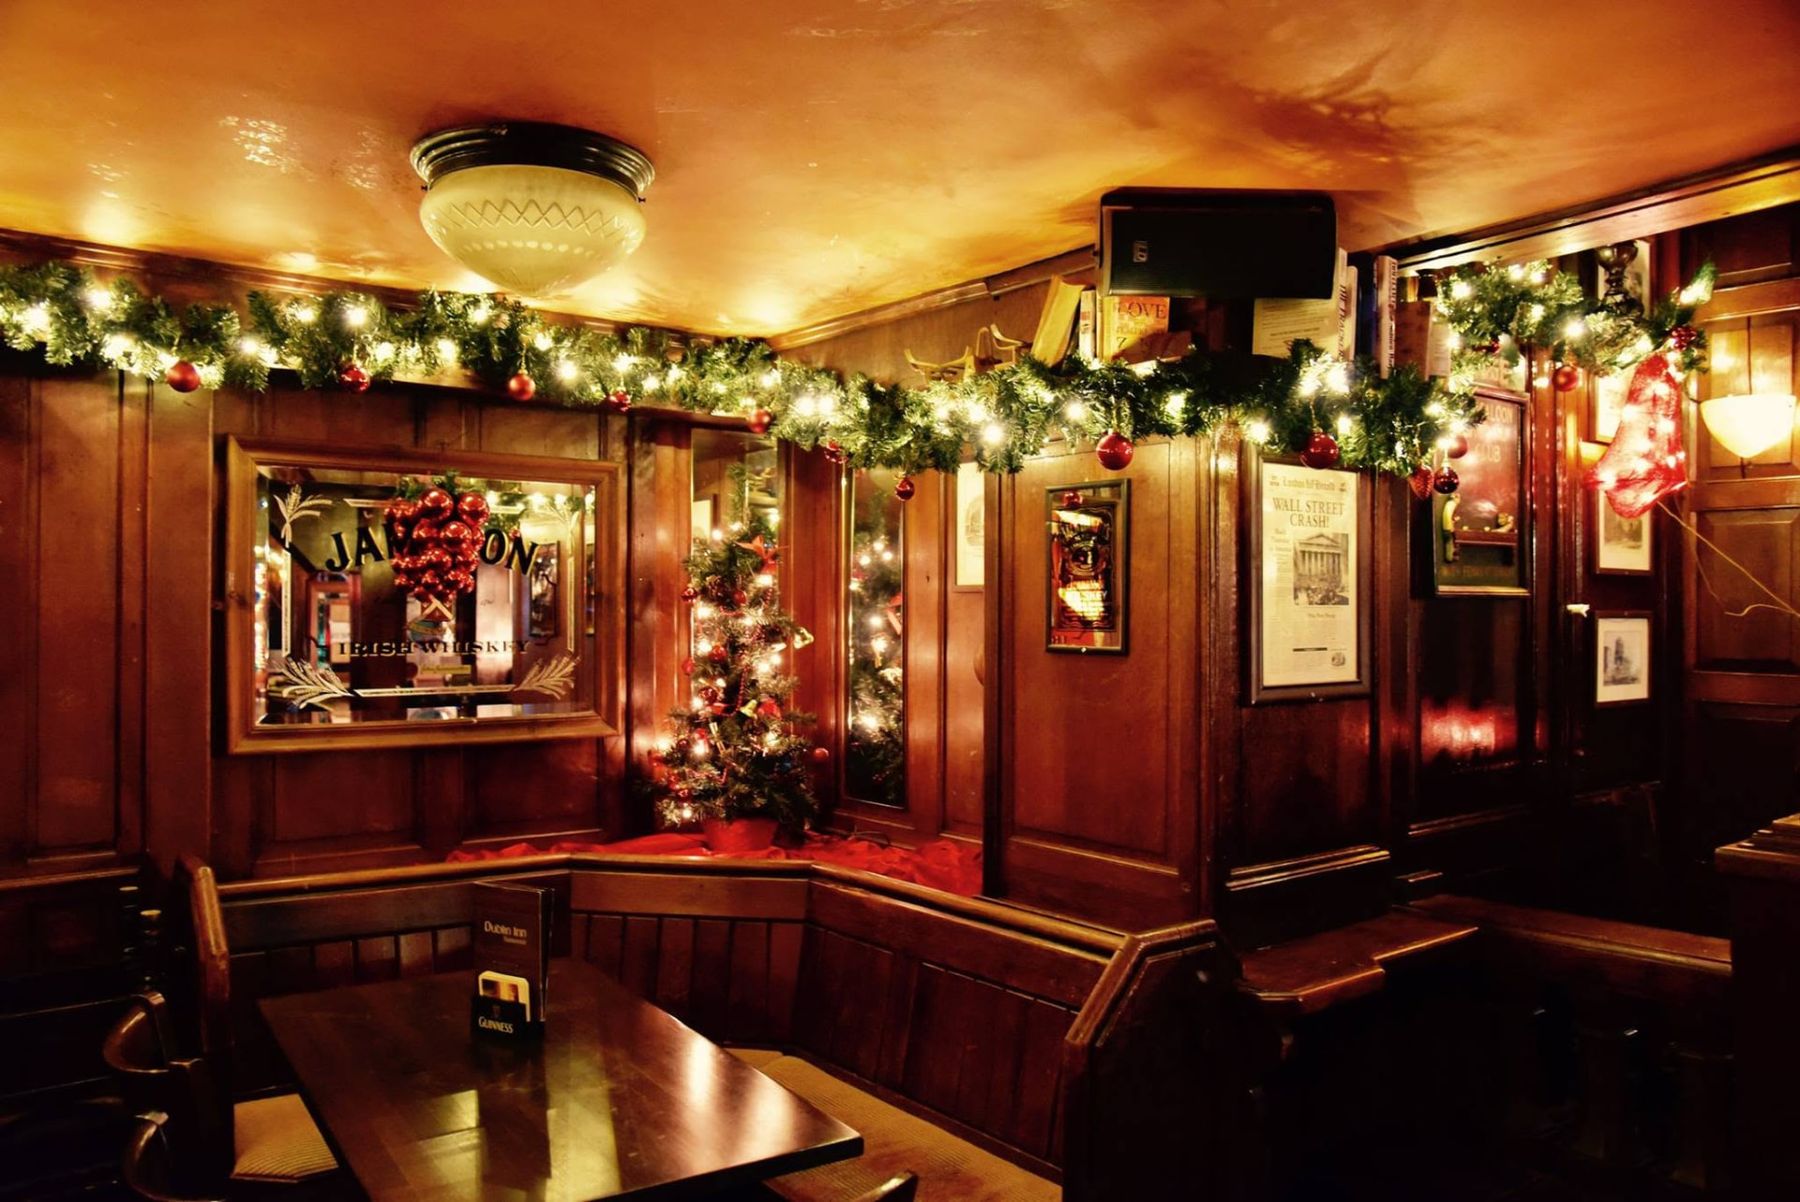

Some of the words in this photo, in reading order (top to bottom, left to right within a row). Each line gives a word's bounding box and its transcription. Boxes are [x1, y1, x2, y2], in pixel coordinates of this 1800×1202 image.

[1116, 301, 1167, 320] LOVE
[1272, 497, 1303, 512] WALL
[1305, 500, 1345, 516] STREET
[1290, 512, 1330, 529] CRASH!
[325, 523, 539, 576] JAON
[338, 641, 414, 656] IRISH
[421, 640, 529, 655] WHISKEY
